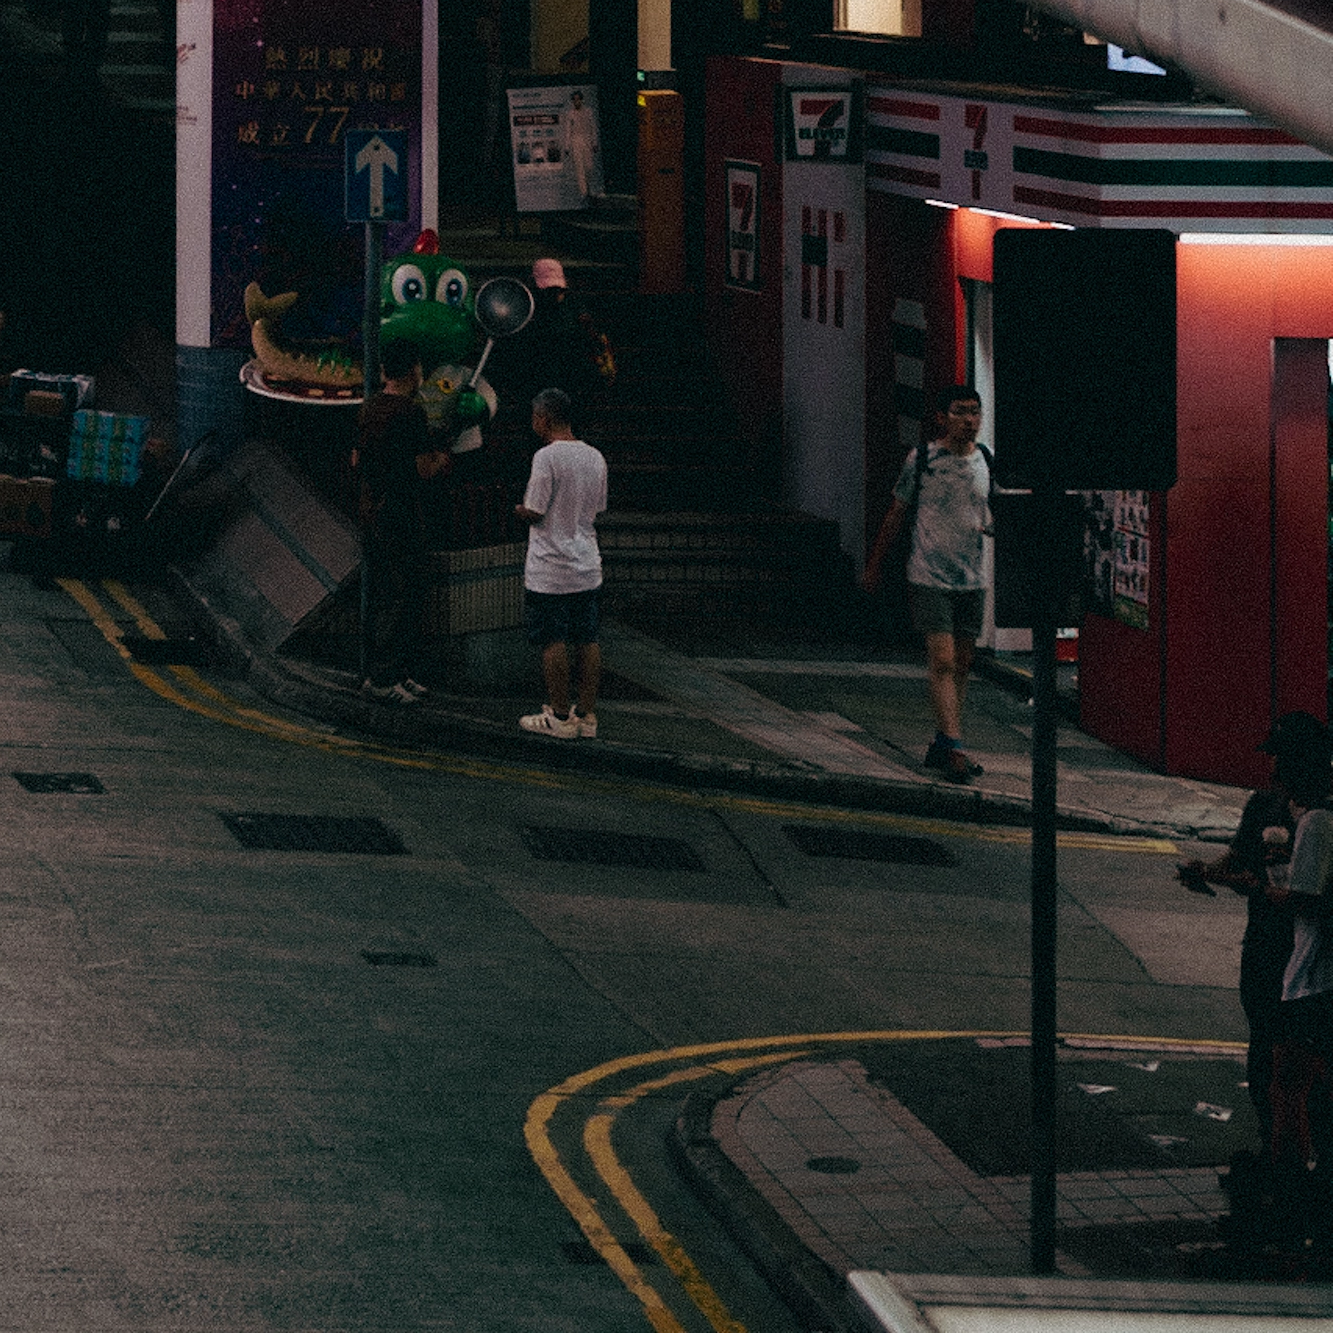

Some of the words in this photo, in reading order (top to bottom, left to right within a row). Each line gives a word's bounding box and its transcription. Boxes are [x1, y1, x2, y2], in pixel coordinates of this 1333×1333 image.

[234, 79, 407, 102] 中華人民共和國
[801, 100, 844, 156] 7
